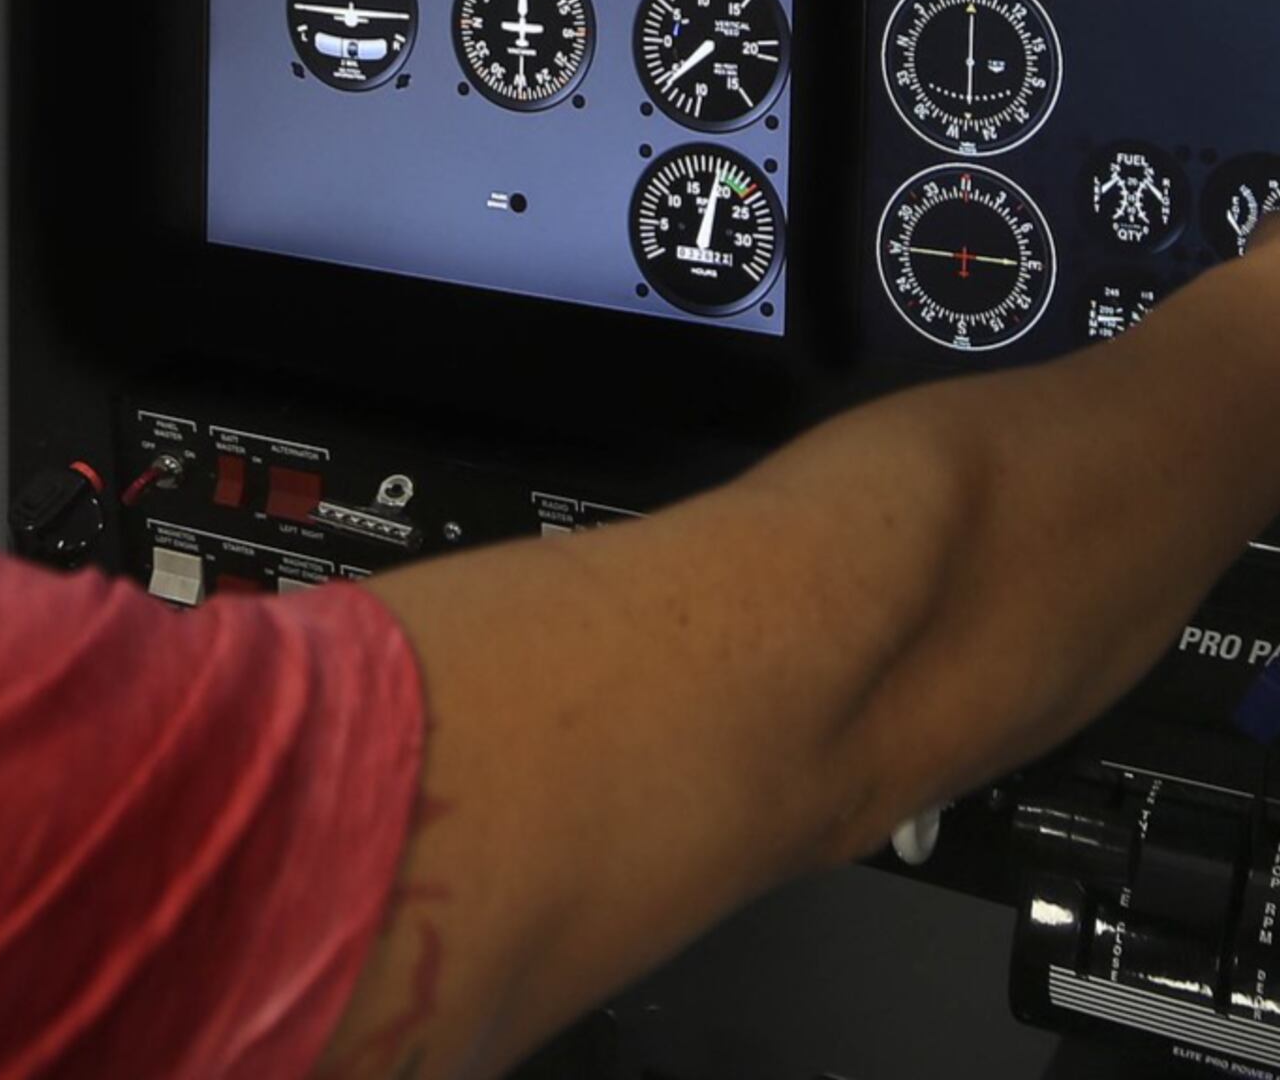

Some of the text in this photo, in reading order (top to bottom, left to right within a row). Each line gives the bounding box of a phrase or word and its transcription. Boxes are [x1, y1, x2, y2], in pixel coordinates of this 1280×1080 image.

[728, 2, 741, 16] 15
[1012, 3, 1027, 18] 12
[663, 34, 673, 48] 0
[742, 41, 759, 55] 20
[695, 83, 709, 97] 10
[727, 77, 740, 90] 15
[1116, 152, 1149, 167] FUEL
[686, 181, 701, 195] 15
[716, 186, 731, 199] 20
[667, 194, 682, 208] 10
[732, 205, 750, 220] 25
[660, 217, 669, 231] 5
[733, 233, 753, 248] 30
[1117, 228, 1144, 242] QTY
[156, 420, 179, 432] PANEL
[153, 428, 183, 441] MASTER
[216, 442, 246, 455] MASTER
[271, 444, 320, 461] ALTERNATOR
[542, 499, 569, 513] RADIO
[538, 509, 575, 524] MASTER
[279, 524, 324, 540] LEFT RIGHT
[222, 541, 256, 557] STARTER
[1178, 625, 1243, 661] PRO
[1259, 901, 1278, 945] RPM
[1173, 1046, 1200, 1062] ELITE
[1205, 1054, 1229, 1070] PRO
